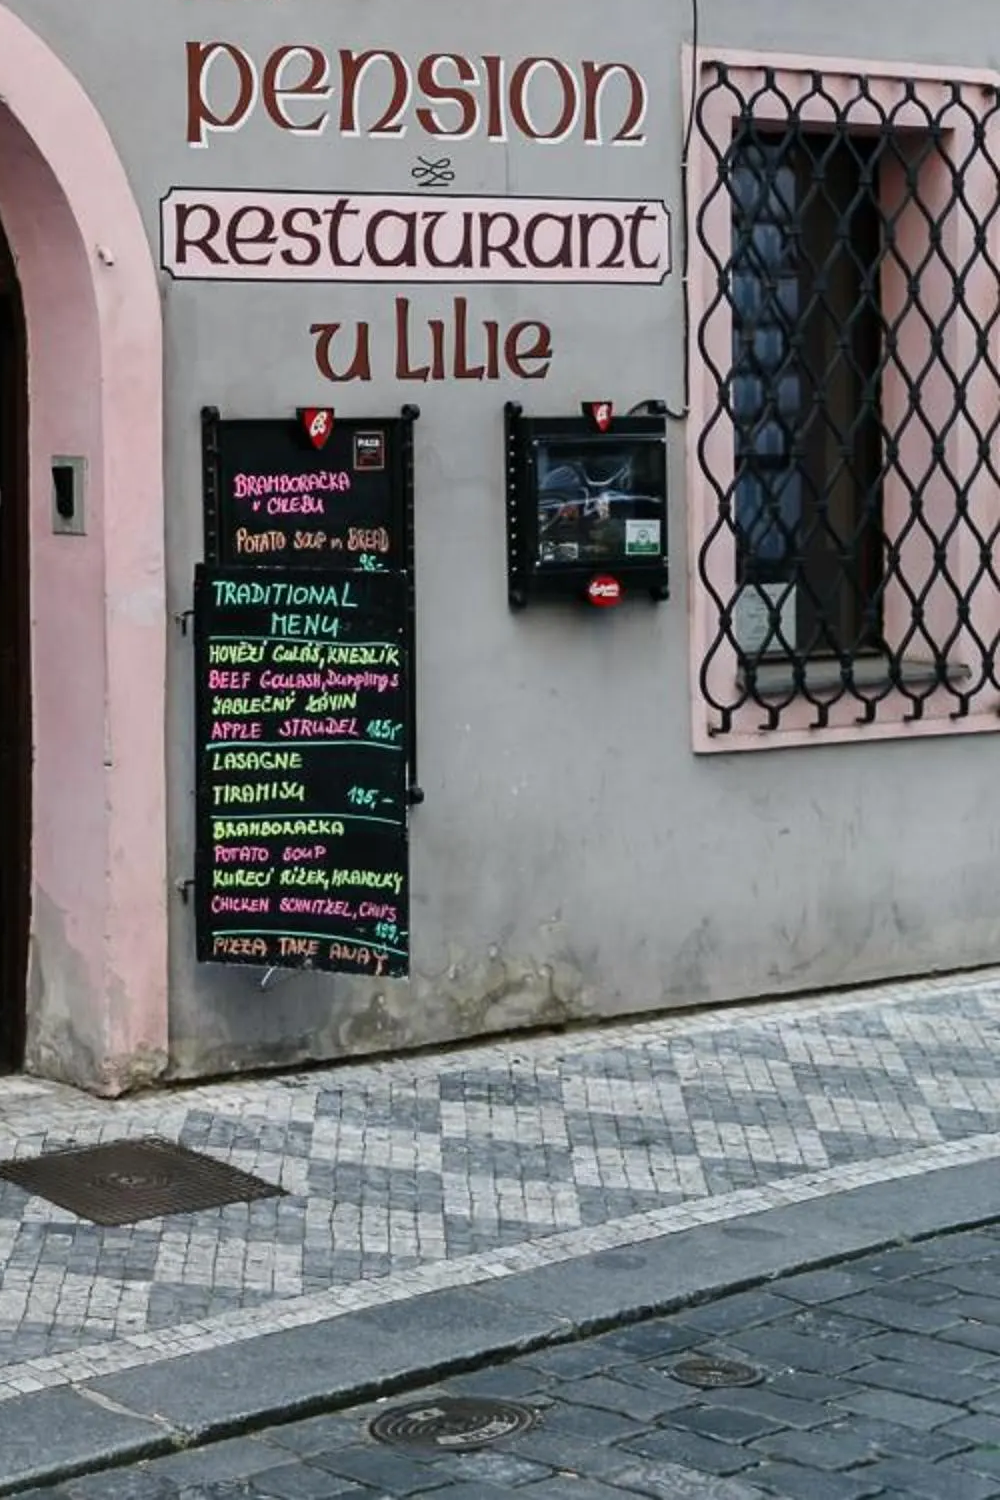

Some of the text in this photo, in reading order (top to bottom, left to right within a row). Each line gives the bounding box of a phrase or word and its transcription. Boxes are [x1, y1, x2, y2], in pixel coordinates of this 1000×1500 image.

[293, 530, 327, 550] SOUP
[347, 526, 390, 553] BREAD
[211, 580, 358, 607] TRADITIONAL
[270, 612, 342, 638] MENU
[208, 669, 251, 690] BEEF
[211, 720, 262, 740] APPLE
[278, 716, 360, 739] STRUDEL
[212, 752, 303, 772] LASAGNE
[211, 780, 306, 806] TIRAMISU
[212, 818, 345, 841] BRAMBORAČKA
[213, 844, 327, 864] POTATO SOUP
[210, 894, 270, 914] CHICKEN
[213, 936, 389, 977] PIZZA TAKE AWAY
